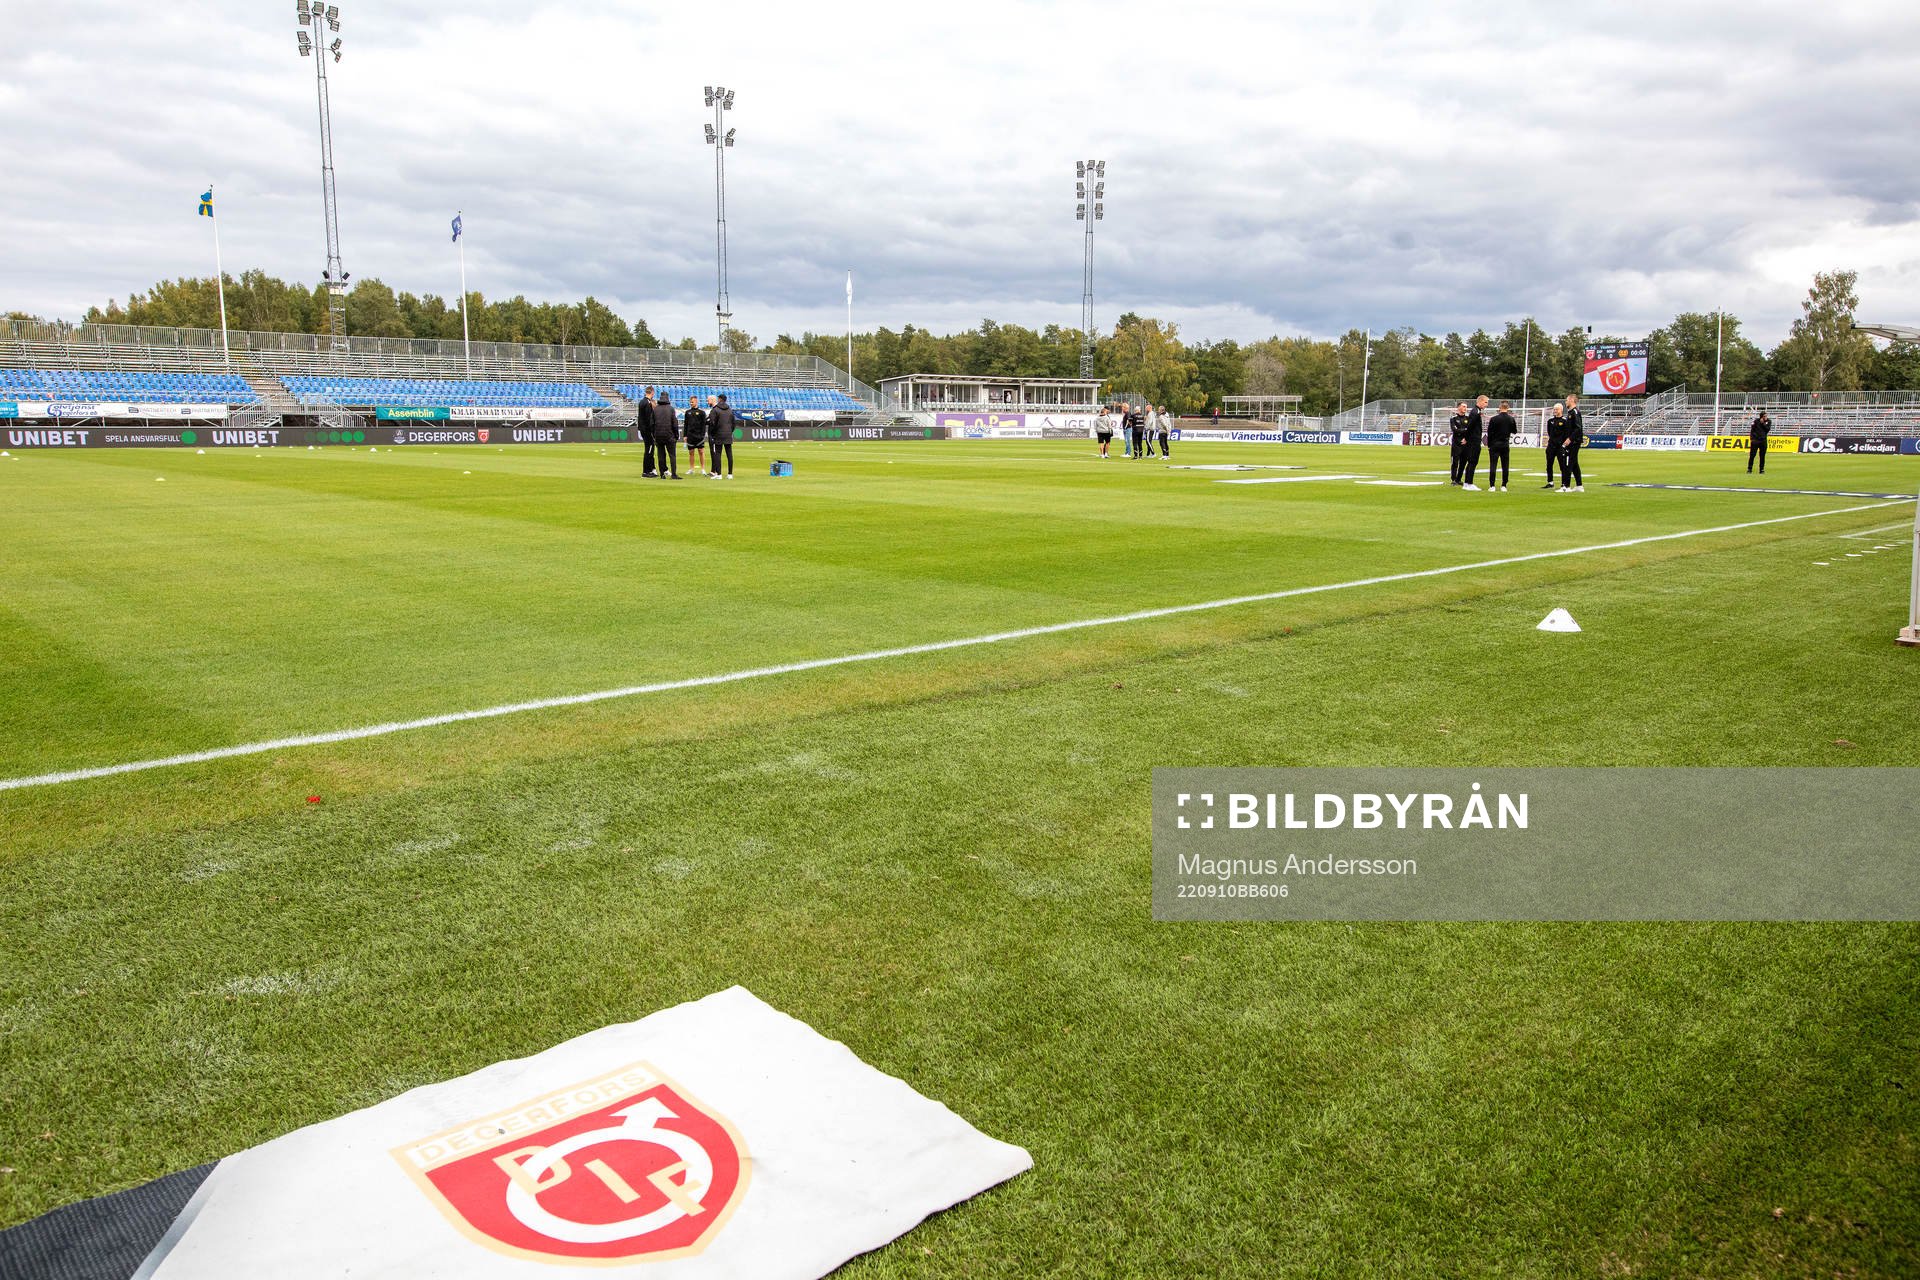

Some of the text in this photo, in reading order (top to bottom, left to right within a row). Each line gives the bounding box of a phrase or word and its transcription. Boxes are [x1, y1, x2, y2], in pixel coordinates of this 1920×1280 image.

[388, 409, 434, 418] Assemblin
[9, 430, 89, 446] UNIBET
[130, 434, 180, 443] ANSVARSFULL
[212, 431, 279, 444] UNIBET
[409, 432, 475, 442] DEGERFORS
[513, 430, 563, 442] UNIBET
[752, 428, 790, 439] UNIBET
[848, 428, 884, 438] UNIBET
[1231, 432, 1282, 441] Vänerbuss
[1286, 432, 1336, 443] Caverion
[1859, 444, 1896, 452] elkedjan
[417, 1072, 647, 1163] DEGERFORS
[492, 1146, 706, 1217] DIF
